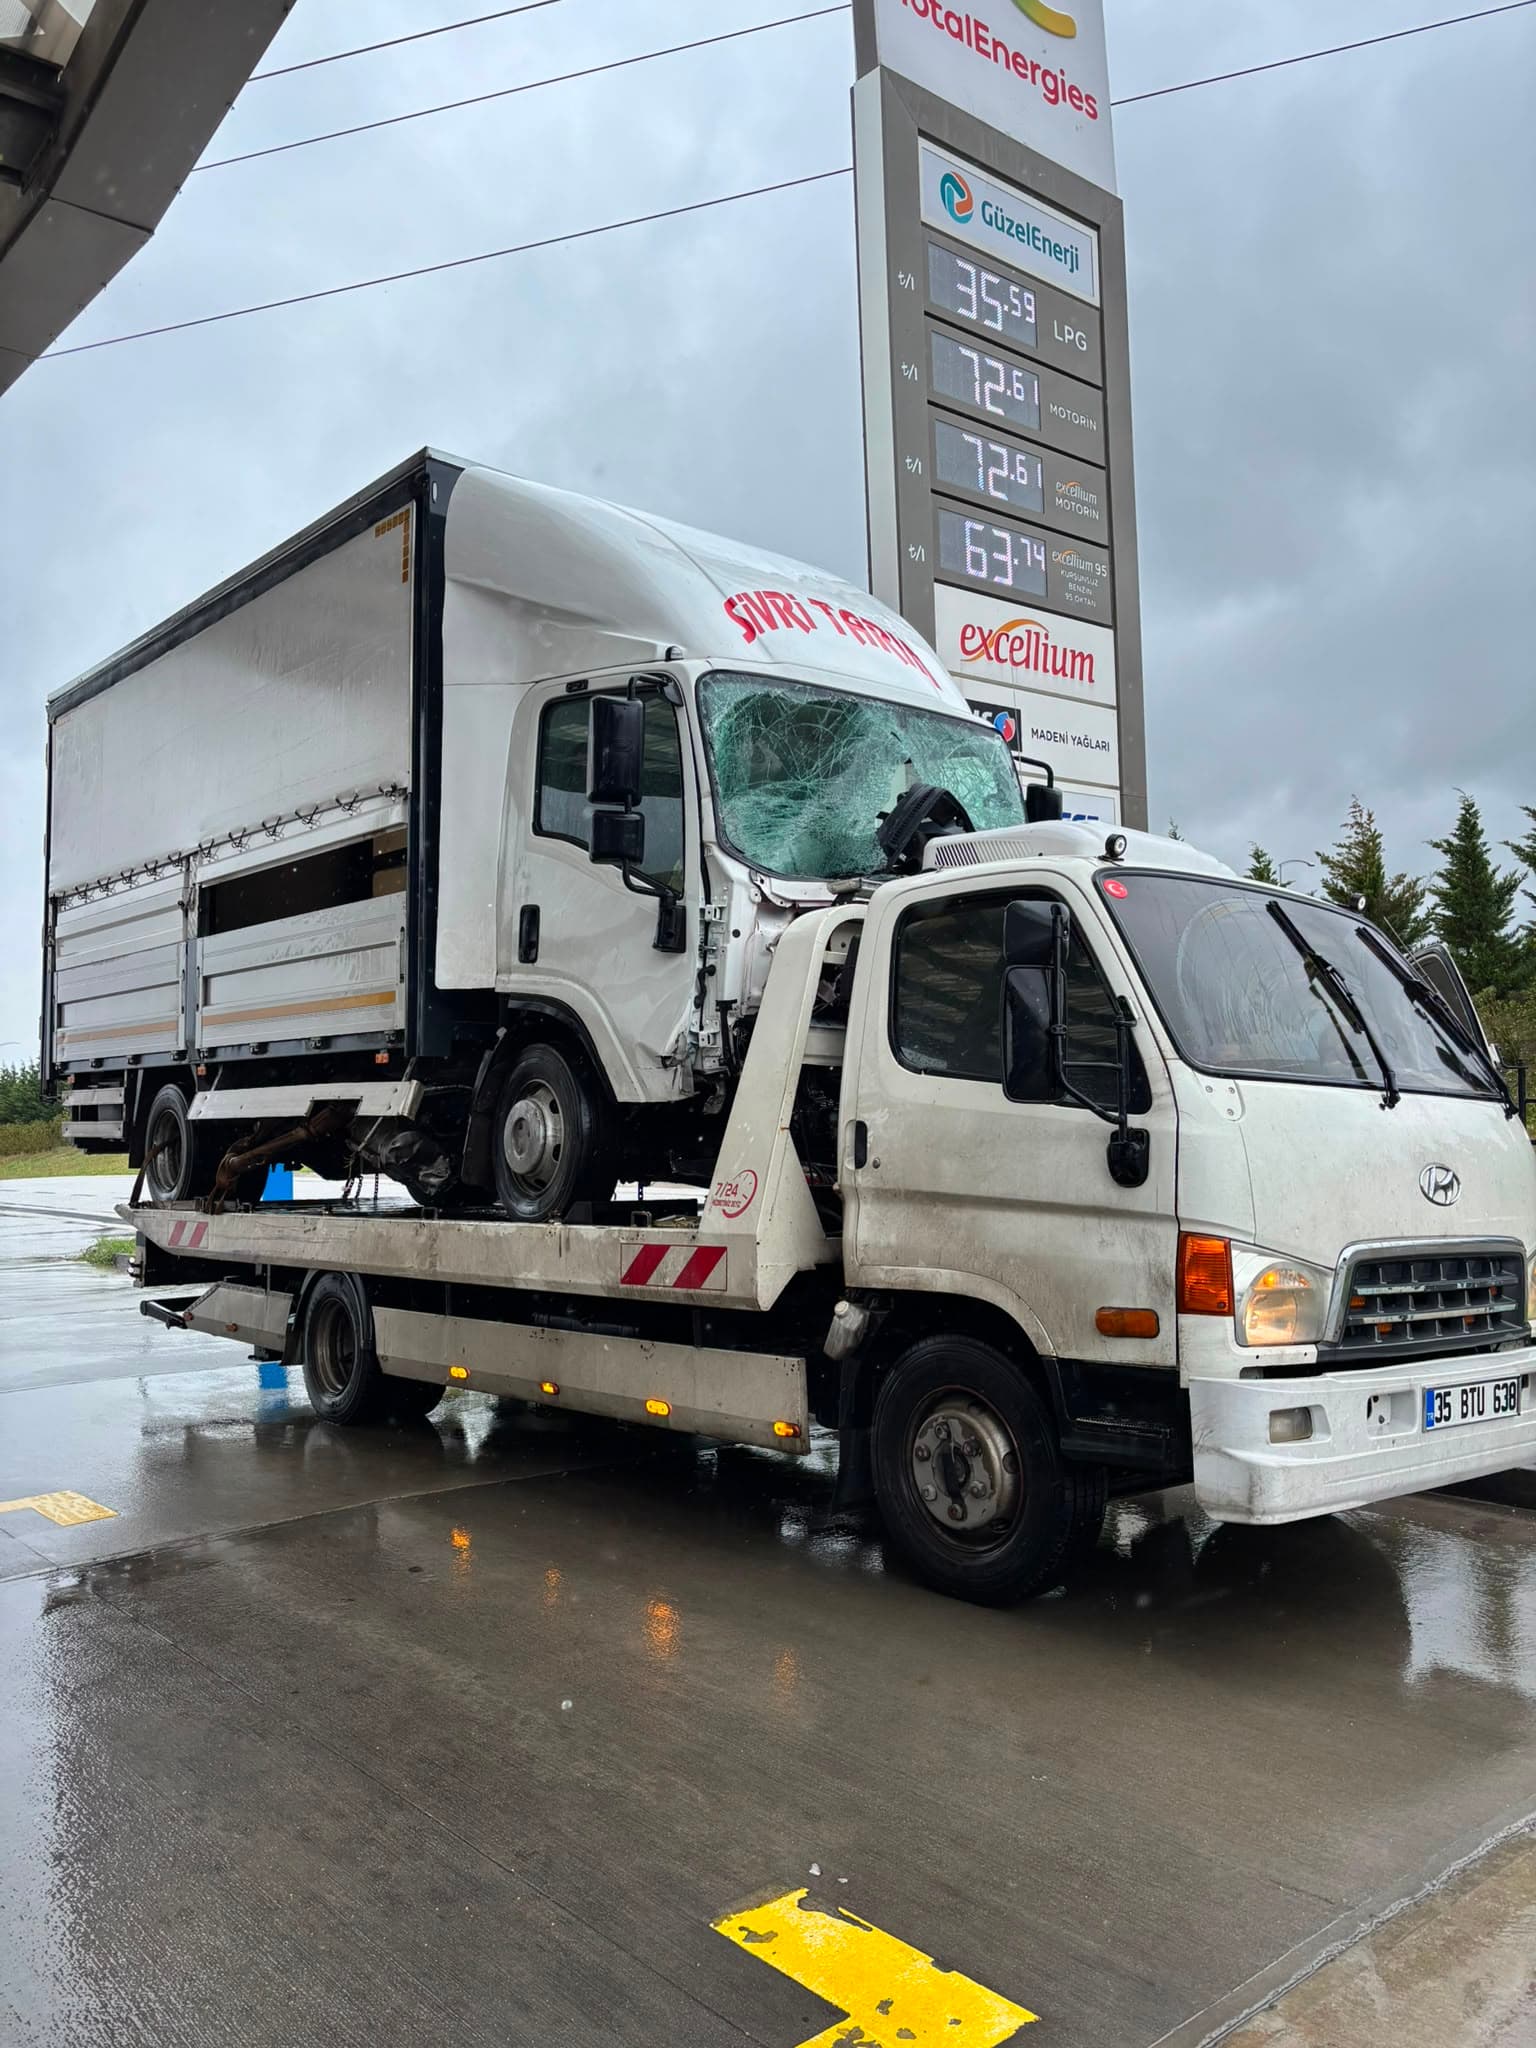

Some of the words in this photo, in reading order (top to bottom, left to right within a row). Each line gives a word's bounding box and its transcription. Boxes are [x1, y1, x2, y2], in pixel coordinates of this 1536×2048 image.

[901, 0, 1098, 120] otalEnergies
[981, 200, 1080, 274] GüzelEnerji
[1053, 320, 1088, 351] LPG
[1055, 480, 1097, 505] excellium
[1052, 550, 1093, 572] excellium
[1094, 563, 1107, 577] 95
[960, 622, 1095, 684] excellium
[1031, 727, 1069, 746] MADENİ
[1071, 734, 1110, 752] YAĞLARI
[714, 1182, 739, 1198] 7/24
[1435, 1390, 1451, 1423] 35
[1461, 1386, 1485, 1419] BTU
[1493, 1381, 1516, 1414] 638
